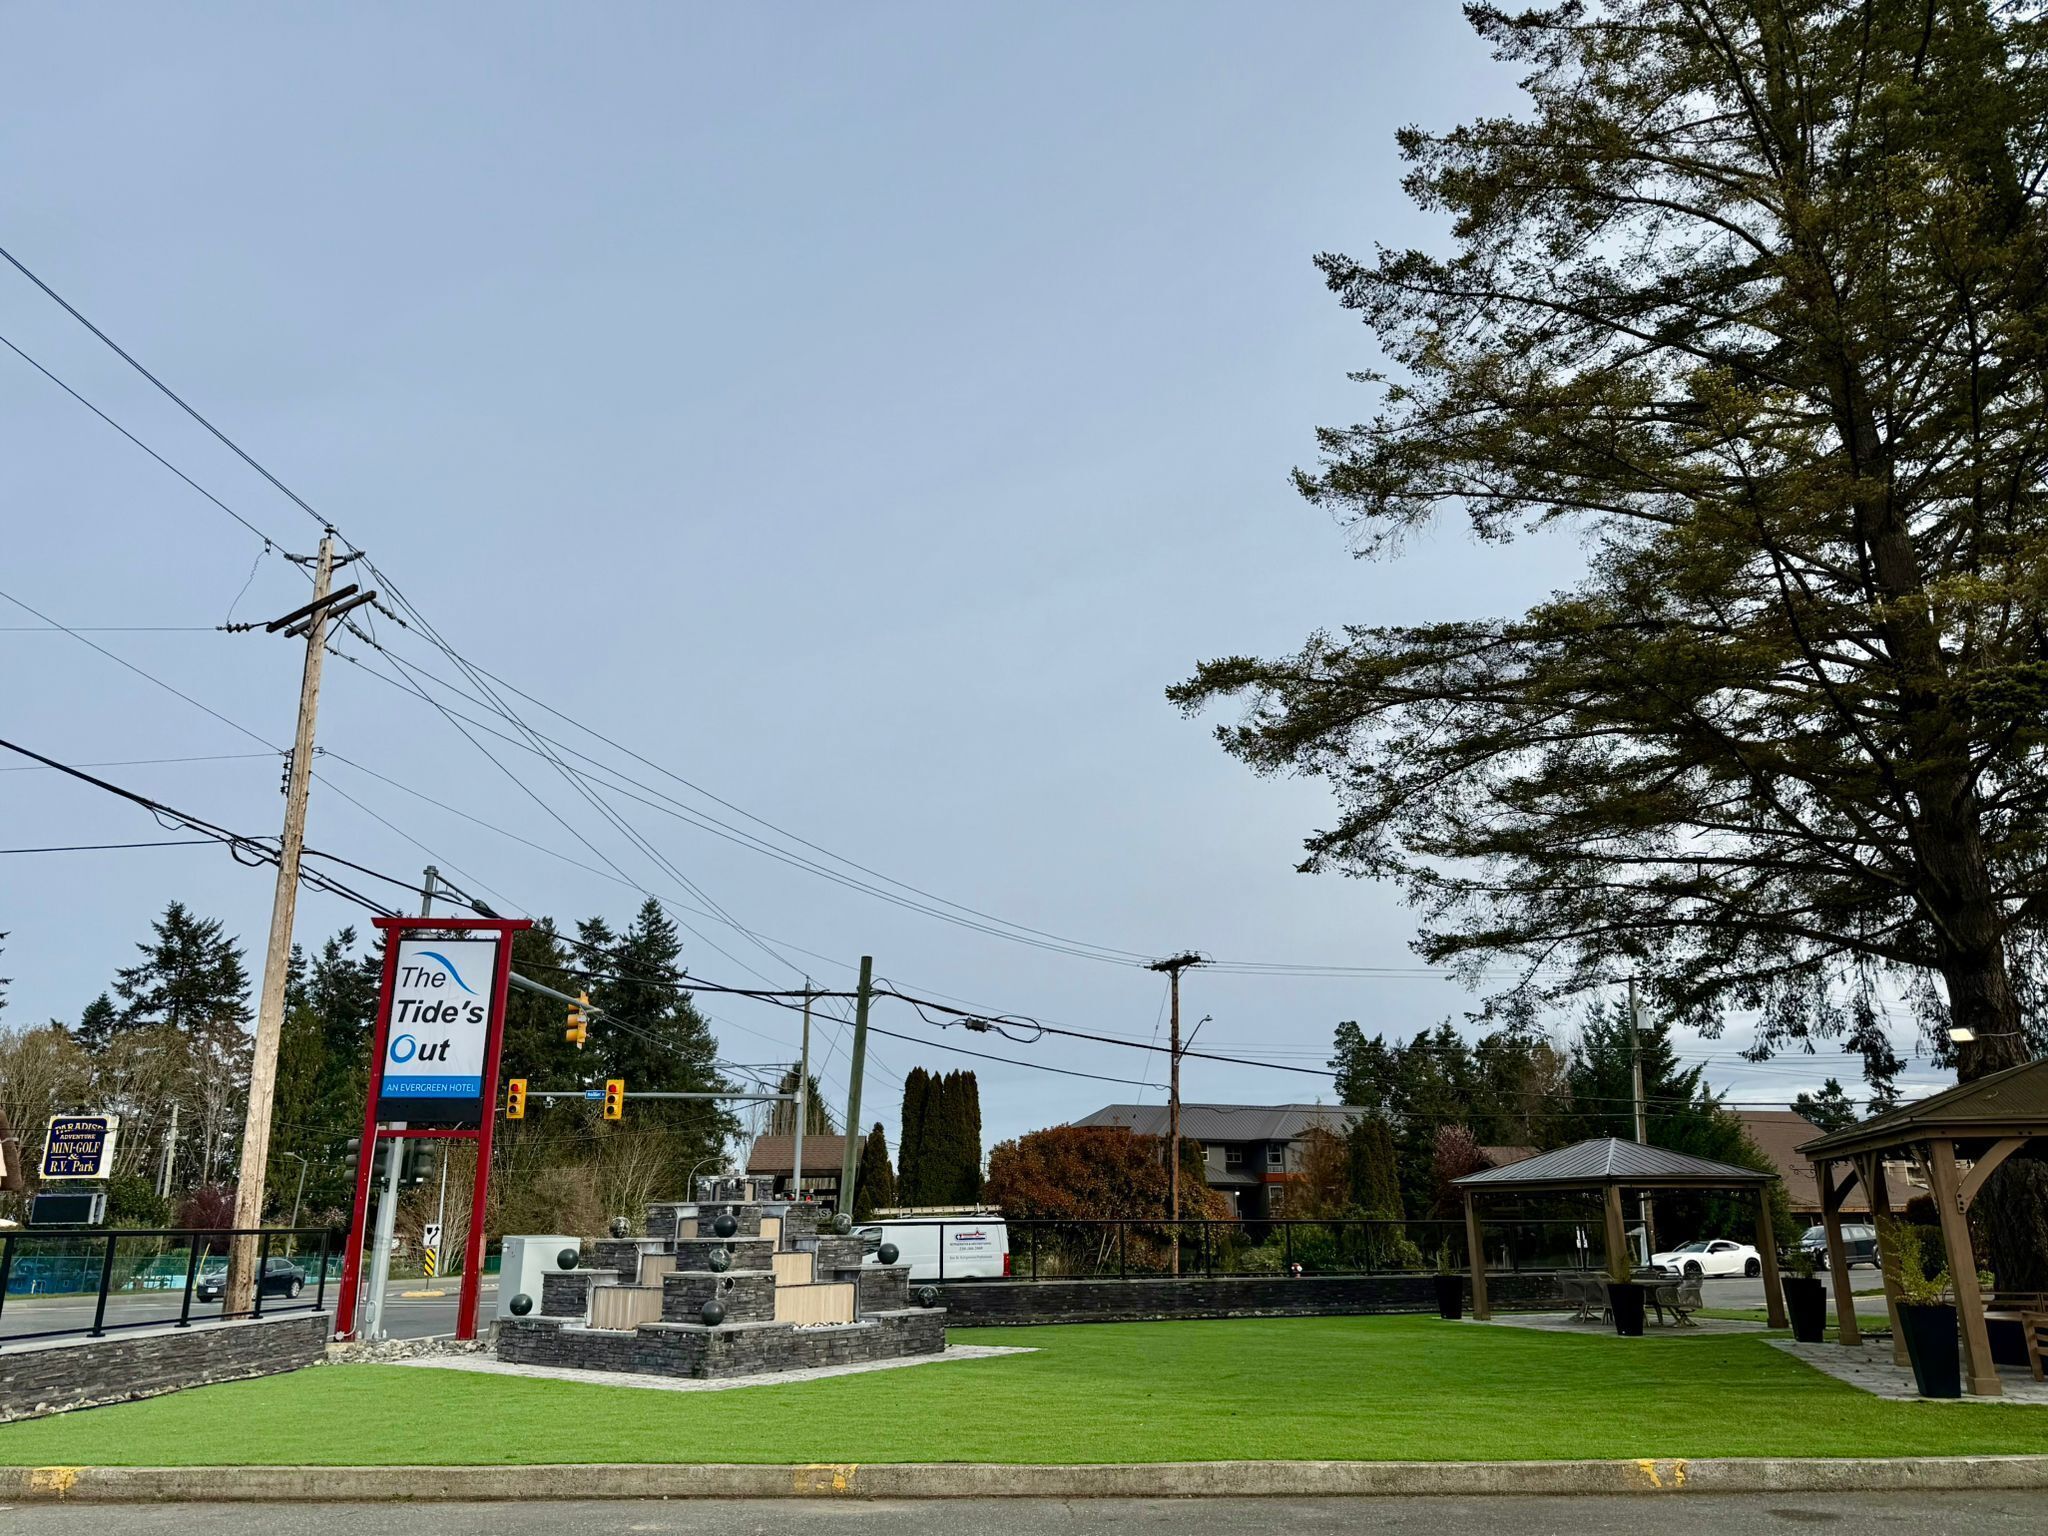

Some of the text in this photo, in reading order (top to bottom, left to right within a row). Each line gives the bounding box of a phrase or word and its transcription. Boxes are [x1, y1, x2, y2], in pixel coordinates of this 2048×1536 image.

[402, 967, 446, 988] The
[397, 1000, 485, 1024] Tide's
[390, 1034, 450, 1064] Out
[386, 1083, 476, 1092] AN EVERGREEN HOTEL
[50, 1142, 101, 1154] MINI-GOLF
[50, 1160, 94, 1173] R.V. Park
